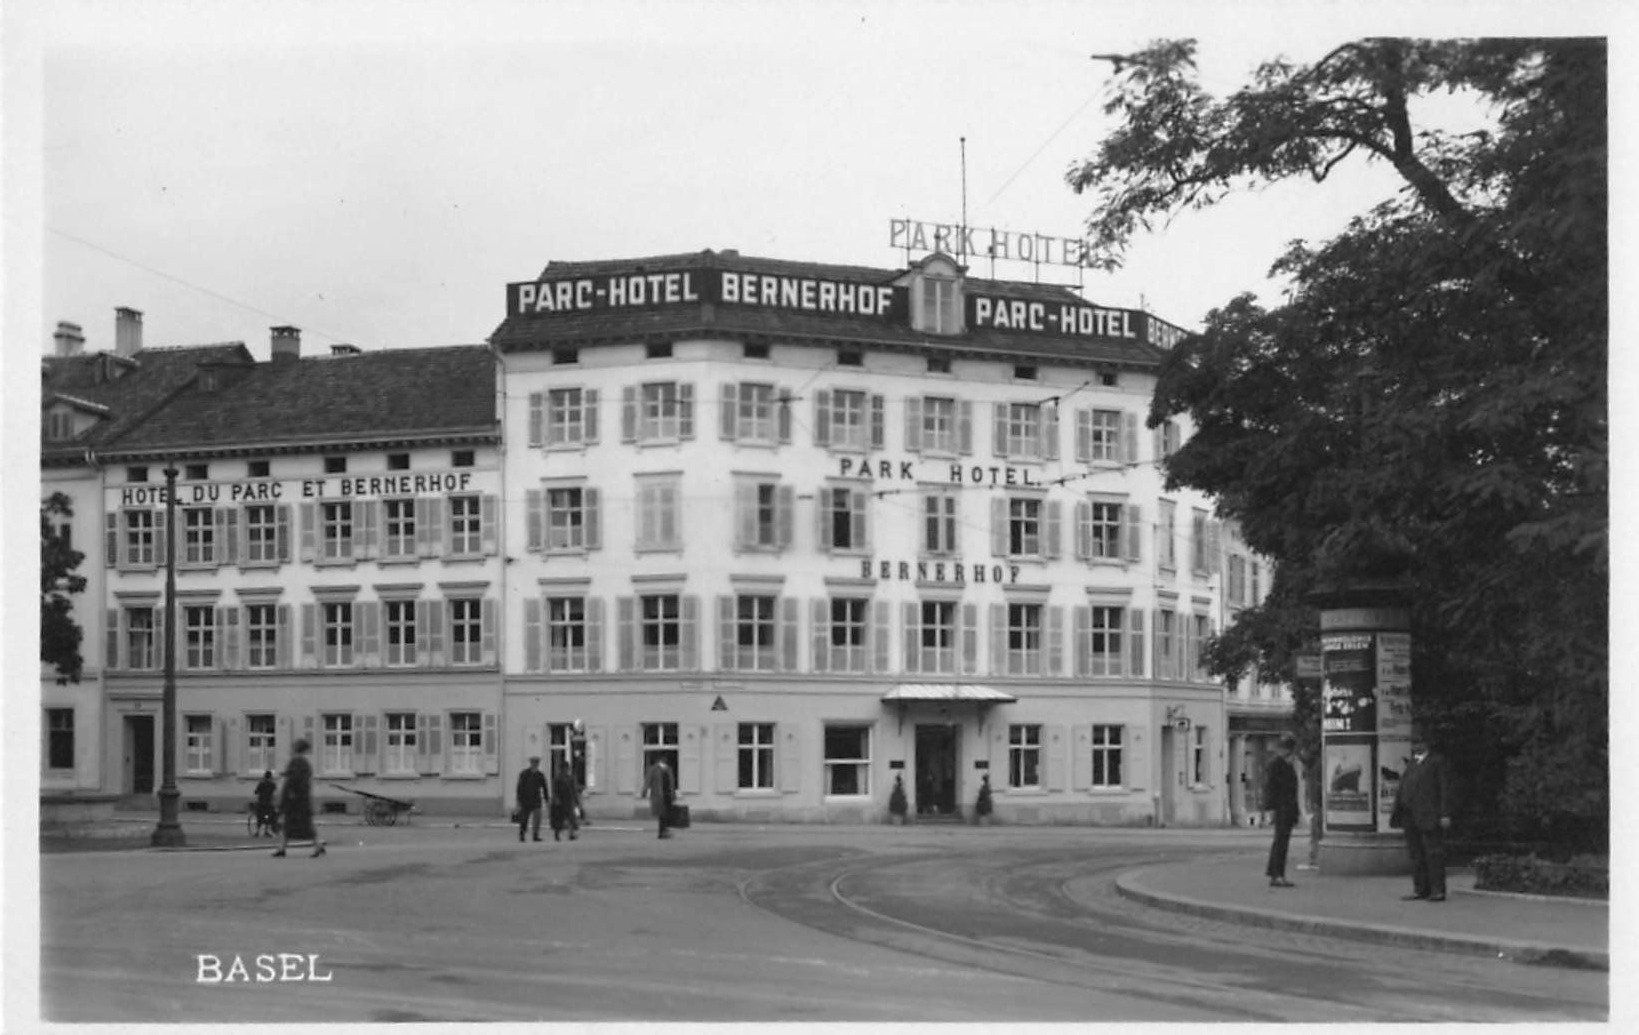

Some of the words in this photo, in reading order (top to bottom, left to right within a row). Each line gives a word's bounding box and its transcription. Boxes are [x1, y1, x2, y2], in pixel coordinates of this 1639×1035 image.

[890, 218, 976, 256] PARK
[518, 272, 698, 314] PARC-HOTEL
[721, 271, 894, 315] BERNERHOF
[975, 298, 1136, 339] PARC-HOTEL
[193, 484, 219, 501] DU
[231, 482, 282, 501] PARC
[303, 480, 326, 498] ET
[341, 473, 472, 497] BERNERHOF
[840, 458, 914, 480] PARK
[861, 560, 1021, 584] BERNERHOF
